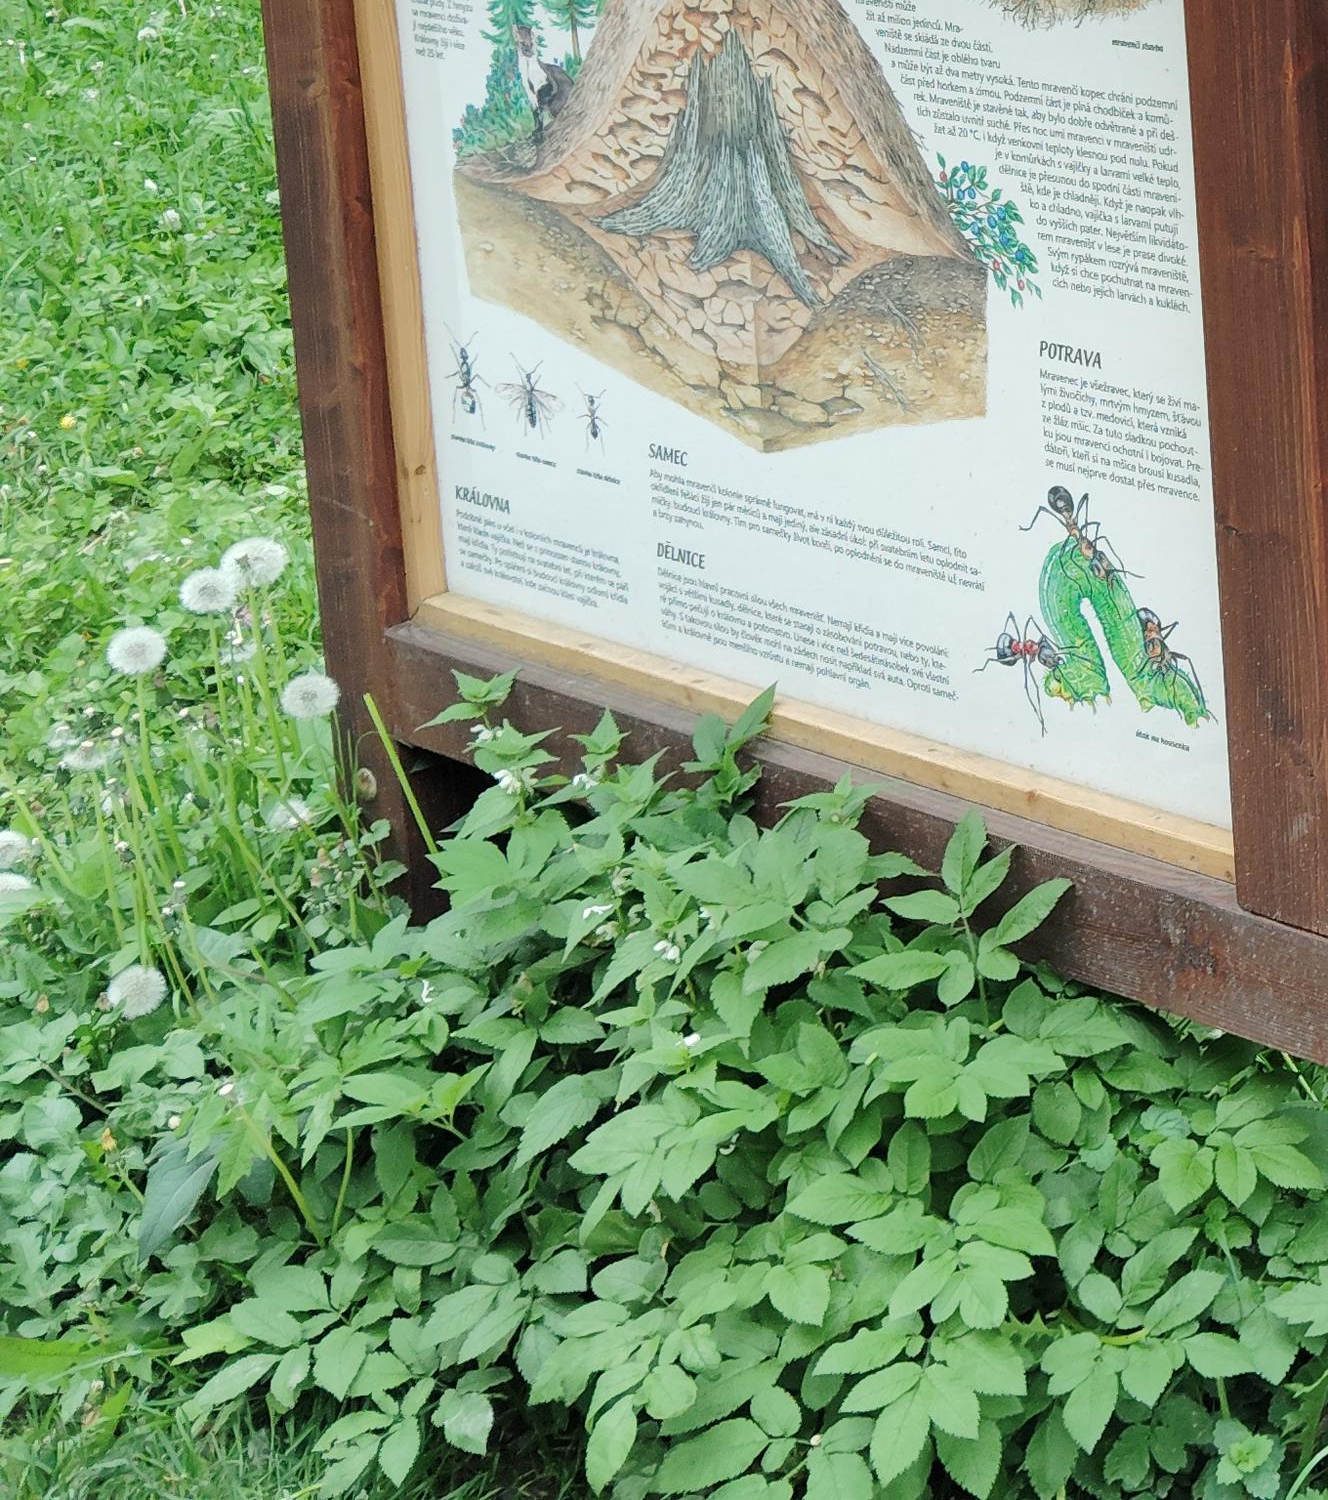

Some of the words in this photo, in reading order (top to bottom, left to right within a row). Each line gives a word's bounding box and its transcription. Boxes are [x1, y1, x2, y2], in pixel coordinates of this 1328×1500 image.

[1039, 340, 1102, 369] POTRAVA
[1039, 367, 1078, 387] Mravenec
[1079, 376, 1088, 390] je
[1132, 387, 1154, 405] který
[1155, 395, 1165, 405] se
[1167, 394, 1181, 409] živí
[1182, 401, 1201, 412] ma-
[648, 443, 688, 467] SAMEC
[1042, 426, 1053, 440] ku
[1054, 428, 1072, 444] jsou
[1073, 436, 1111, 453] mravenci
[1150, 450, 1184, 469] bojovat.
[1186, 458, 1205, 474] Pre-
[1044, 459, 1054, 469] se
[1076, 465, 1107, 481] nejprve
[1108, 470, 1135, 487] dostat
[1136, 477, 1155, 492] přes
[1156, 484, 1201, 502] mravence.
[455, 485, 511, 514] KRÁLOVNA
[657, 541, 706, 569] DĚLNICE
